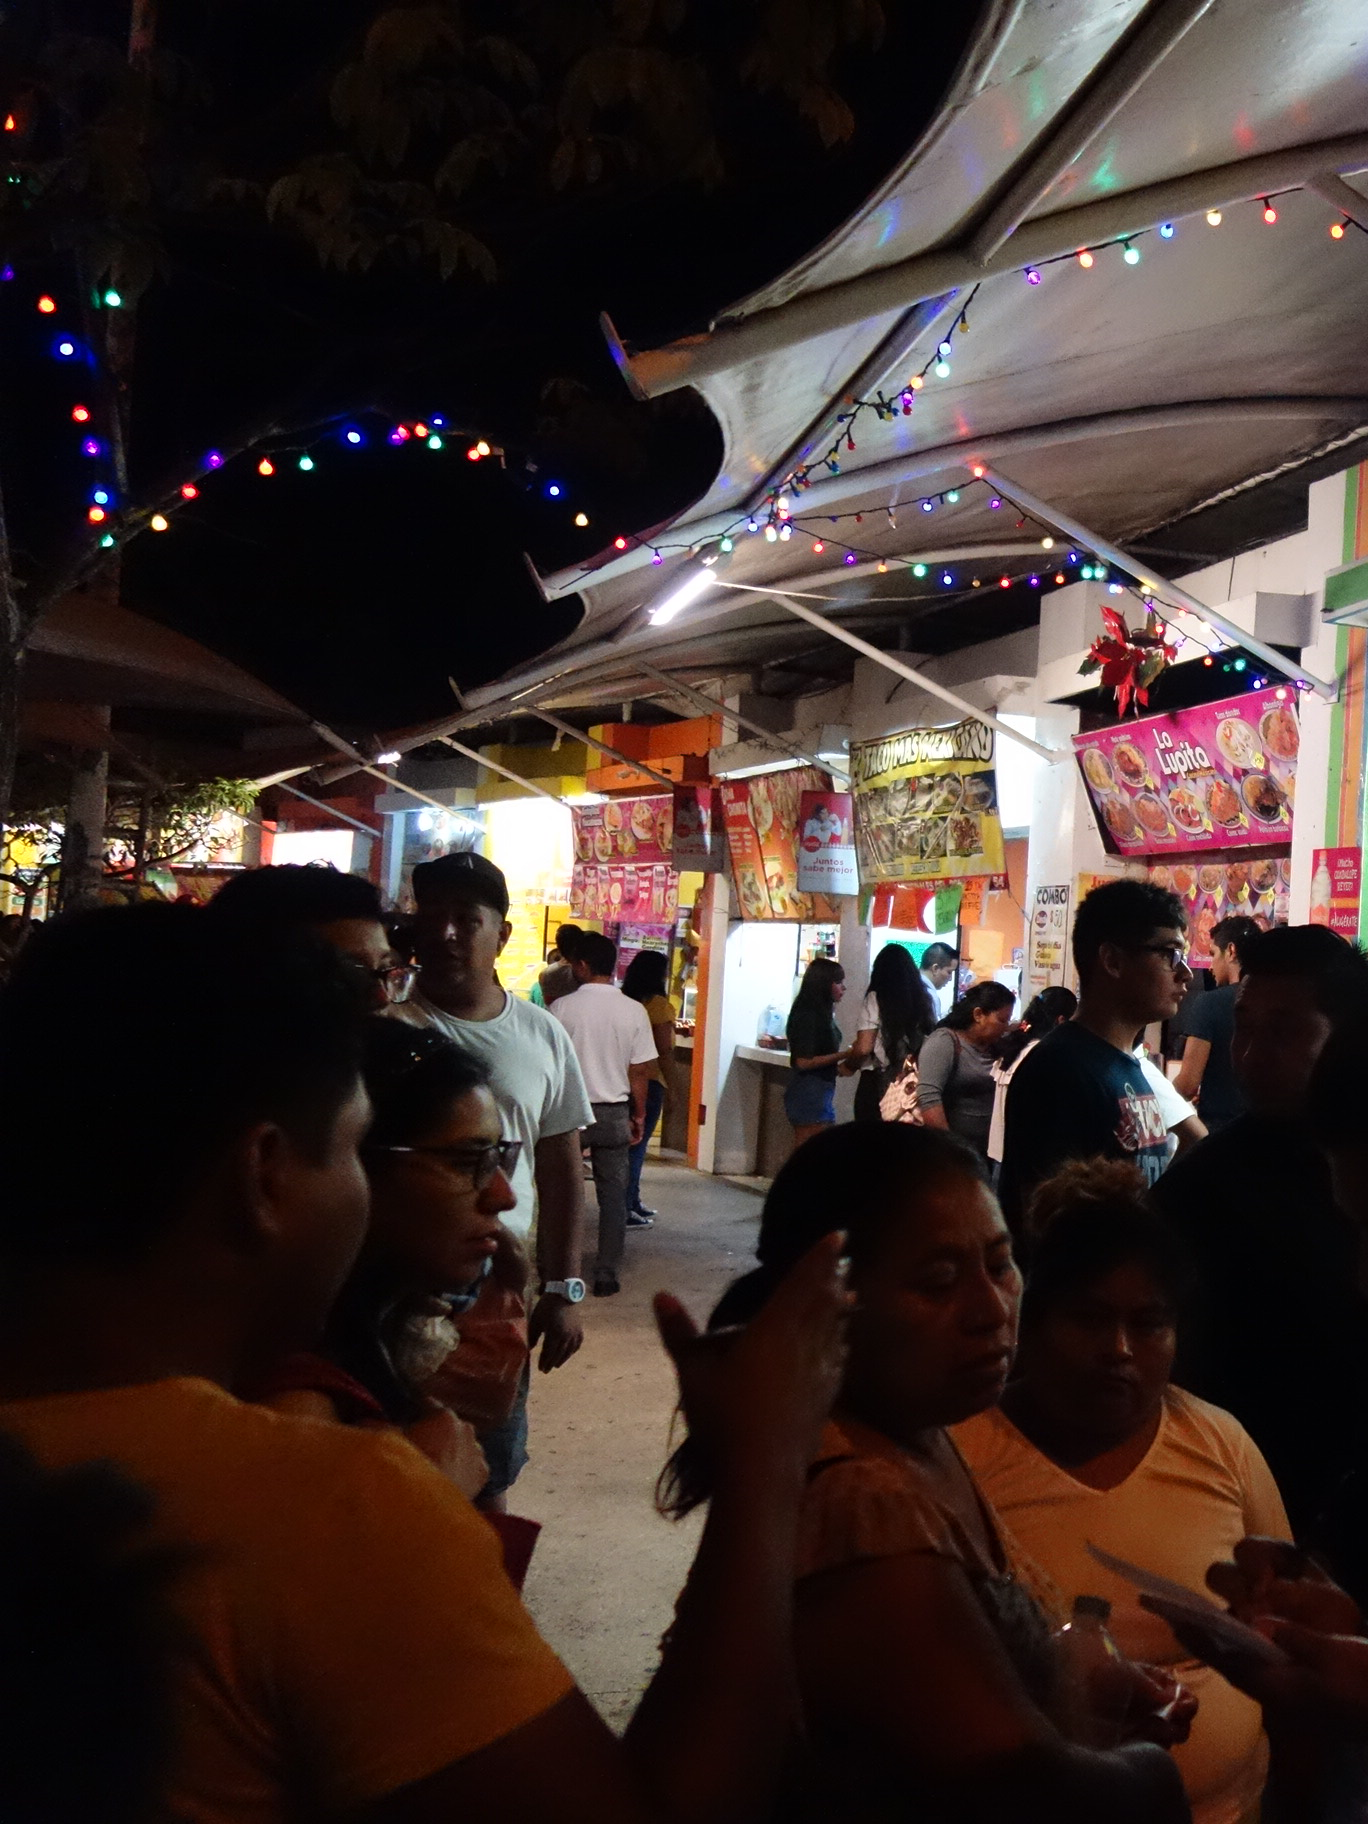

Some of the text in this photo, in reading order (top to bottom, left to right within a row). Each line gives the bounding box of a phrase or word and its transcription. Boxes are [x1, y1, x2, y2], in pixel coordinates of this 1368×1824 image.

[1152, 728, 1173, 749] La
[1155, 741, 1211, 779] Lupita
[803, 864, 854, 875] sabe mejor
[813, 857, 844, 866] Juntos
[1036, 888, 1067, 905] COMBO
